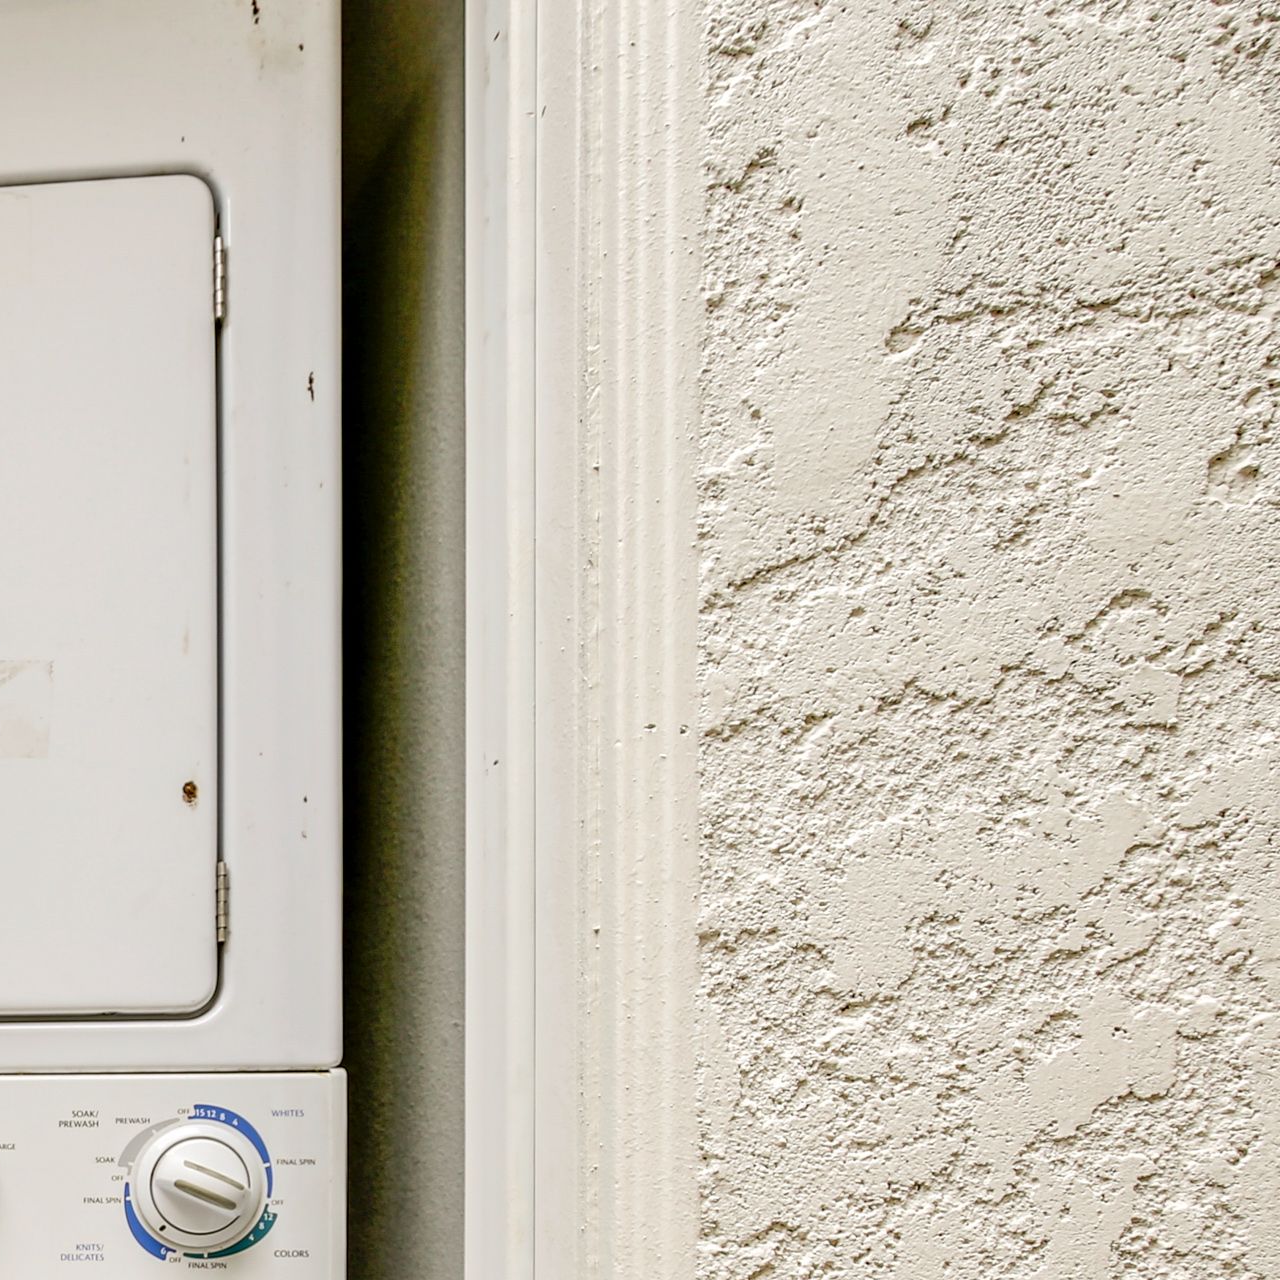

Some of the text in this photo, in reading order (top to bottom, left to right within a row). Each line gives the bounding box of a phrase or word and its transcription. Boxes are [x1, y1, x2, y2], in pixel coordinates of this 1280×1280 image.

[72, 1110, 99, 1118] SOAK/
[59, 1120, 99, 1128] PREWASH
[76, 1244, 104, 1252] KNITS/
[60, 1253, 104, 1261] DELICATES
[274, 1250, 309, 1258] COLORS
